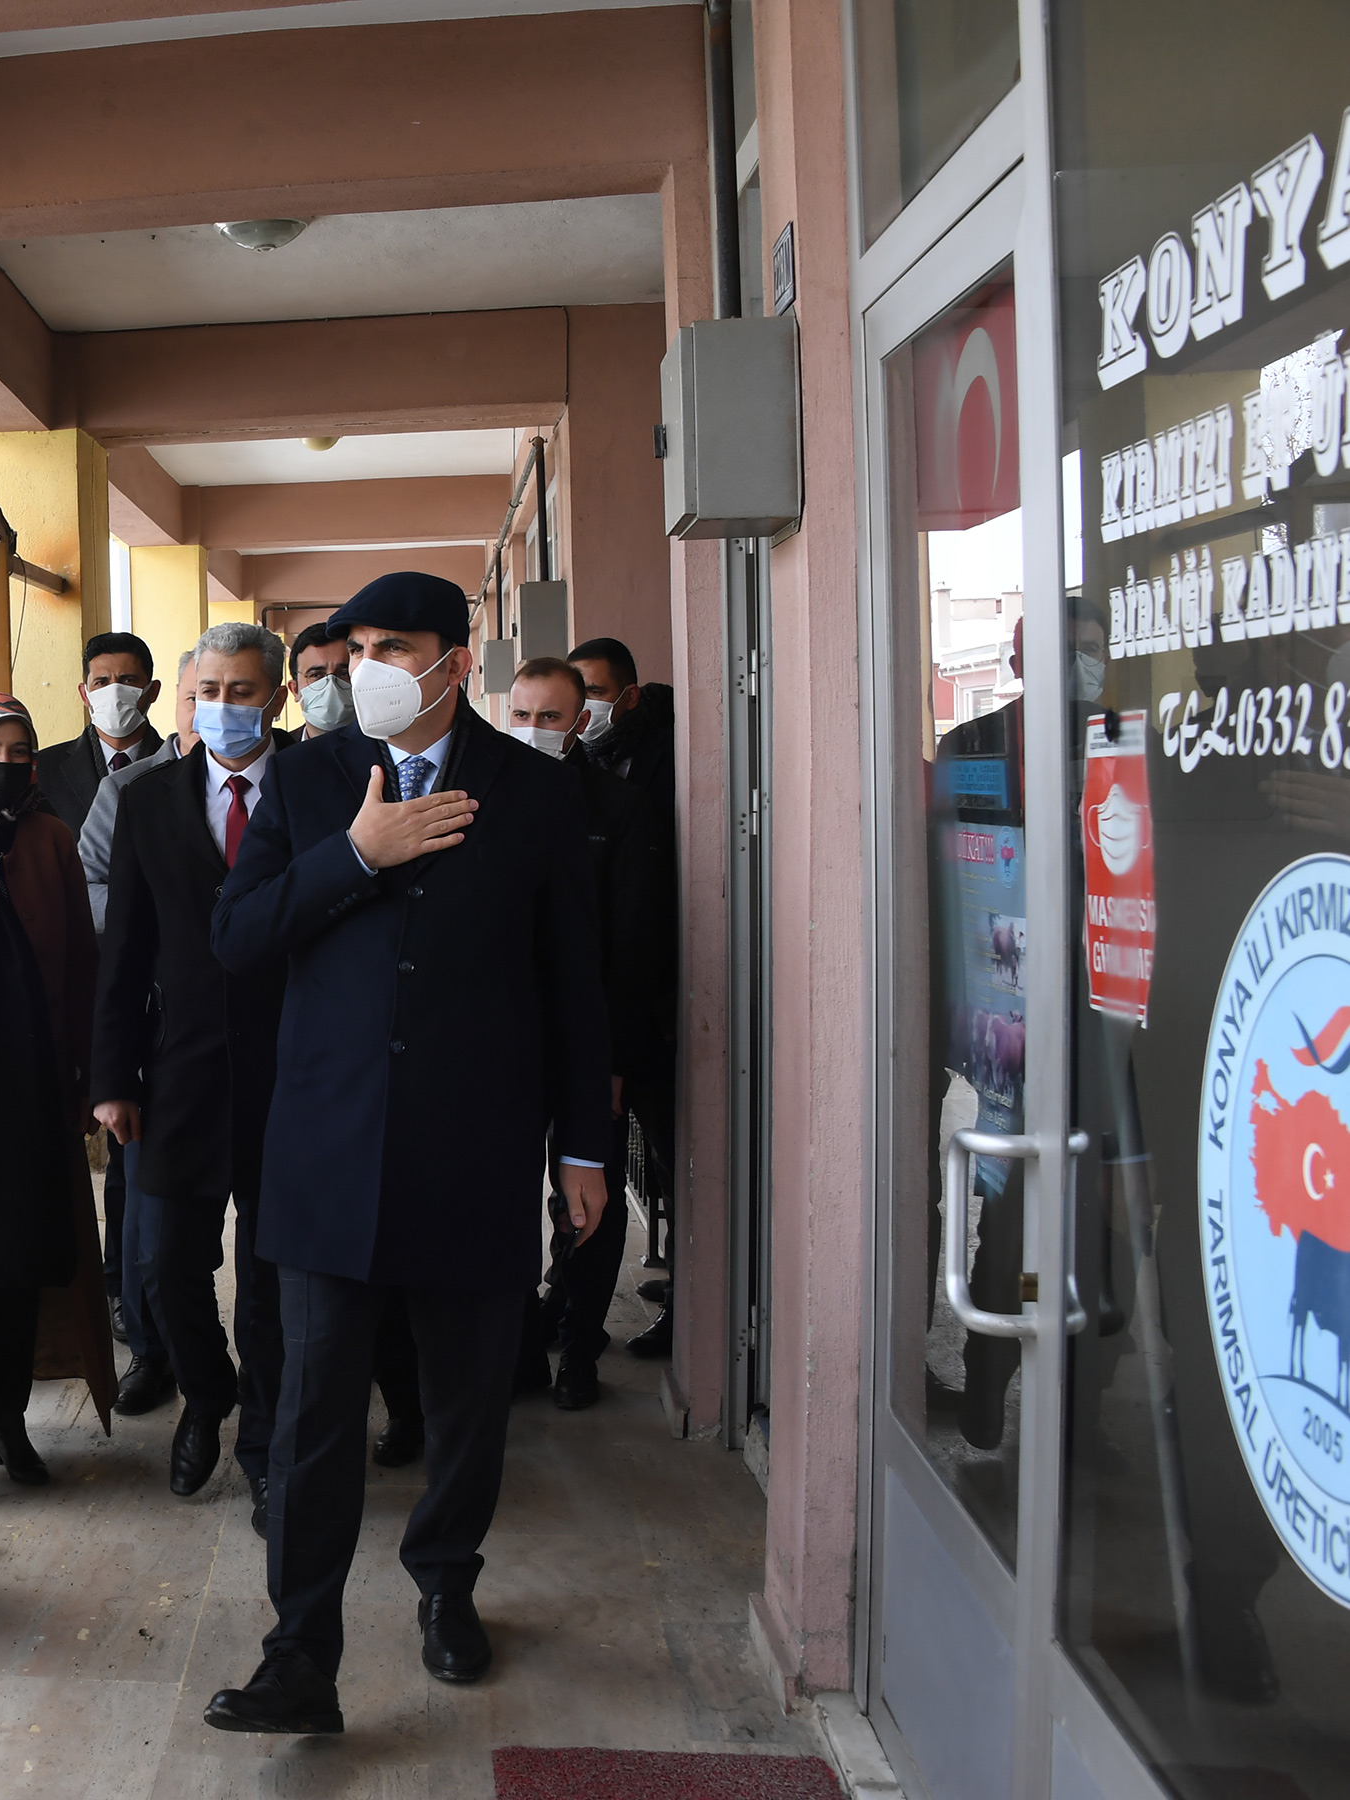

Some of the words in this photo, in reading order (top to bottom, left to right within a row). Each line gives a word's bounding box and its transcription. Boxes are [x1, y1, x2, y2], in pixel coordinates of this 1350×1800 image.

[1100, 402, 1234, 543] KIRMIZI
[1109, 543, 1214, 660] BİRLİĞİ
[1319, 681, 1350, 770] 8
[1208, 977, 1253, 1151] KONYA
[1244, 910, 1274, 985] İLİ
[1207, 1189, 1258, 1454] TARIMSAL
[1302, 1406, 1343, 1464] 2005
